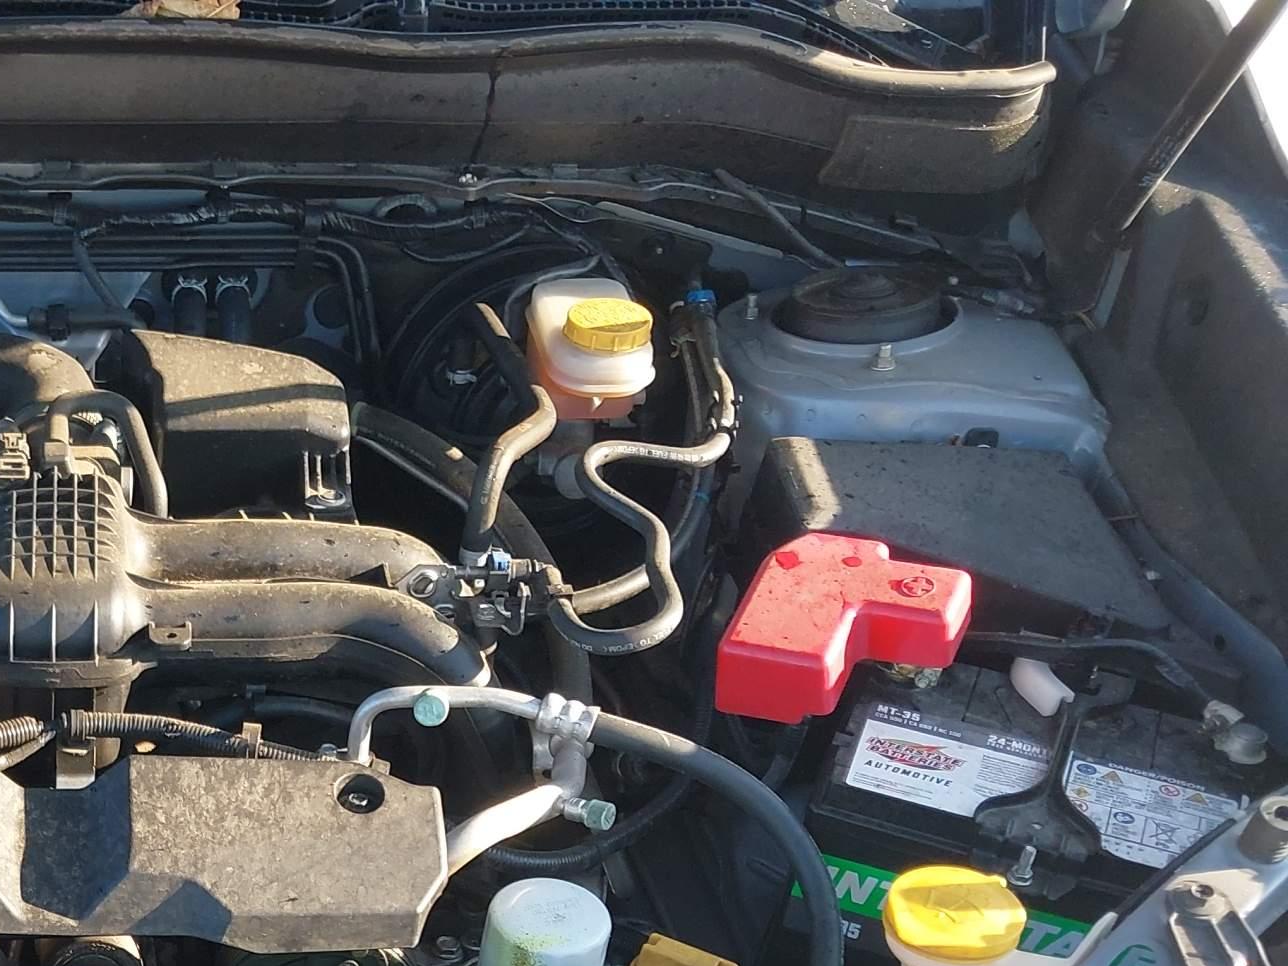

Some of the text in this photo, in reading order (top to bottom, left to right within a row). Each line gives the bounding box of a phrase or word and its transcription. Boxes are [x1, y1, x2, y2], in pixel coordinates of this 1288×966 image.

[865, 745, 957, 773] BATTERIES
[866, 735, 967, 767] INTERSTATE
[864, 759, 953, 787] AUTOMOTIVE
